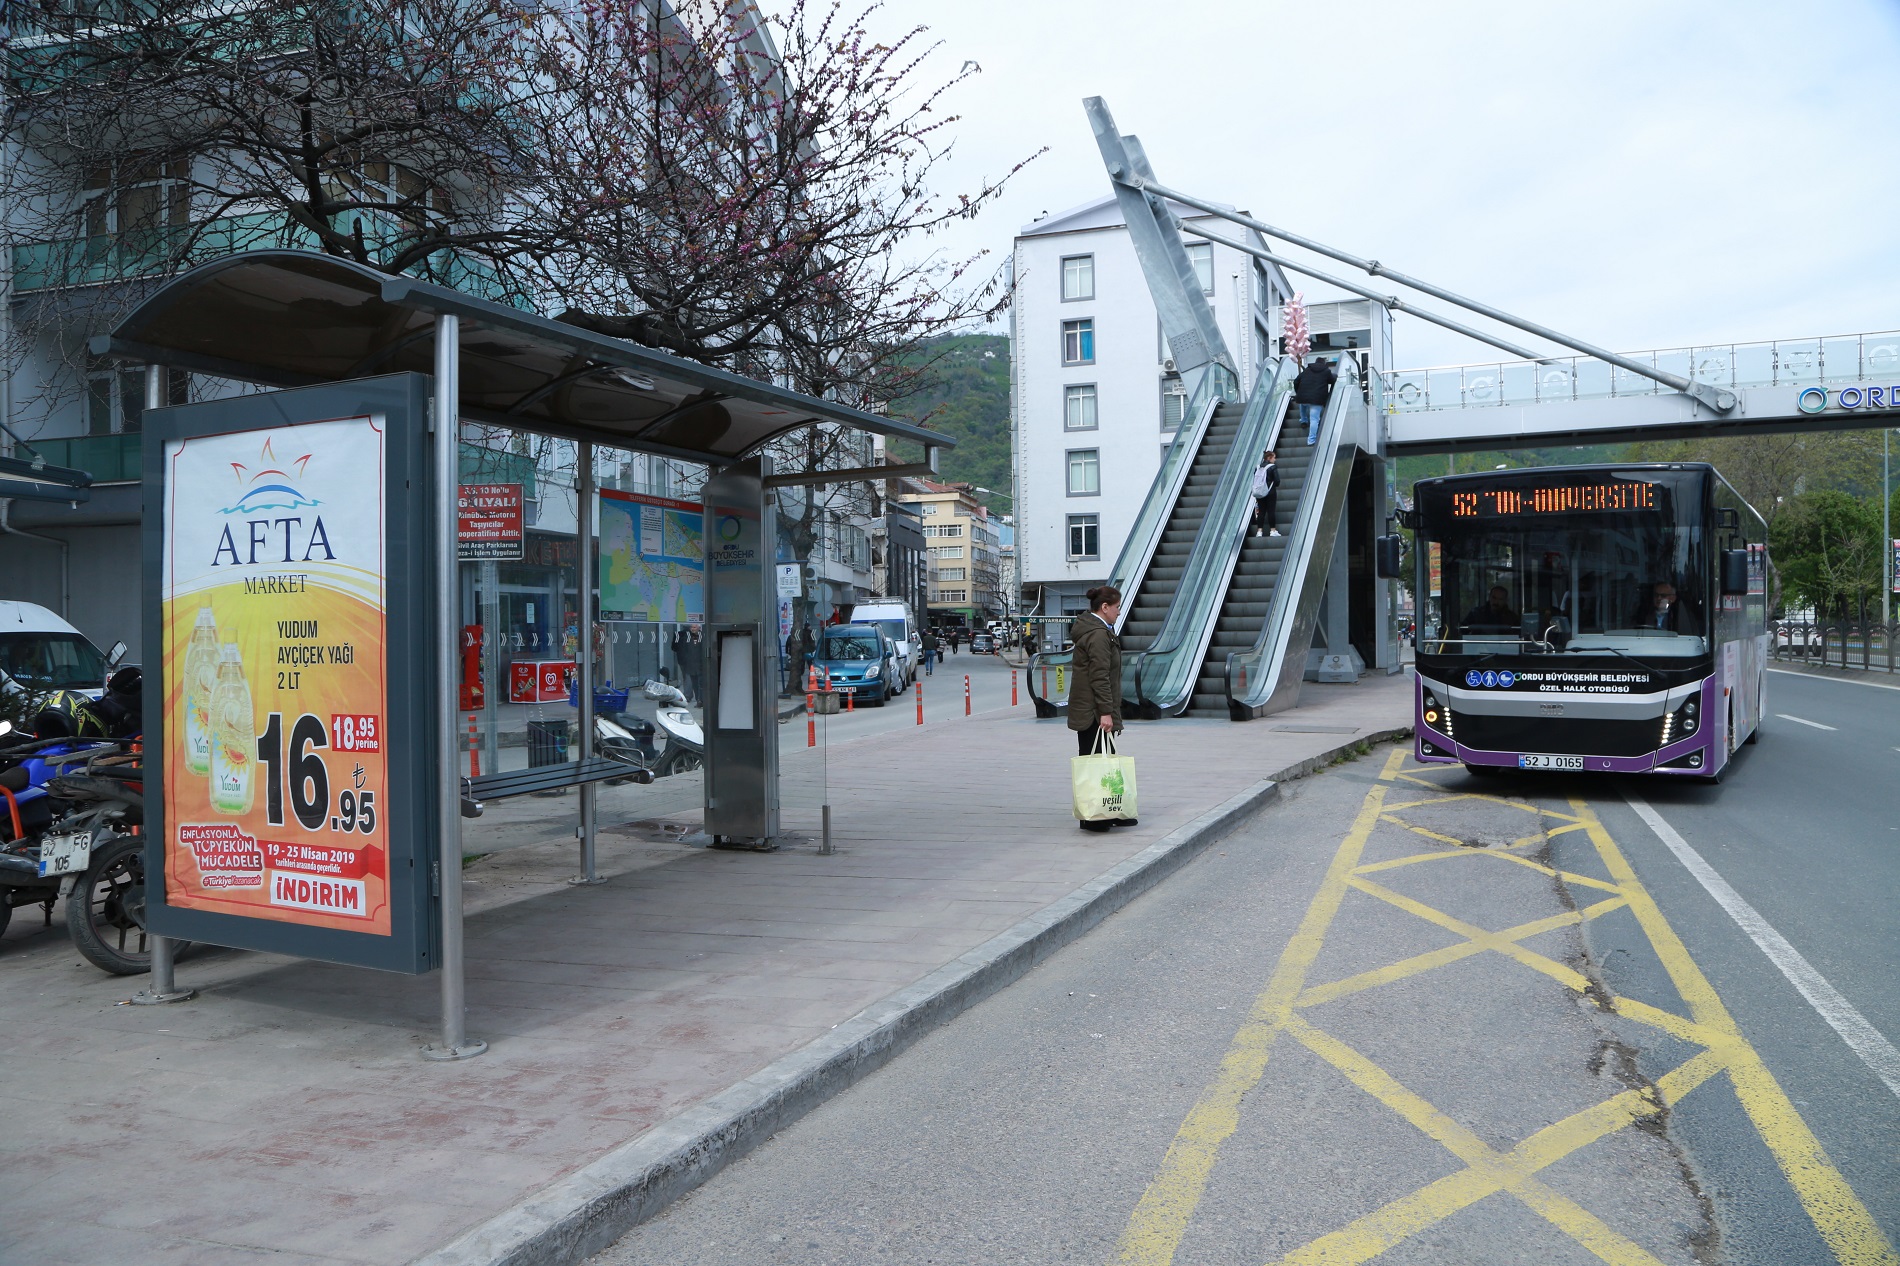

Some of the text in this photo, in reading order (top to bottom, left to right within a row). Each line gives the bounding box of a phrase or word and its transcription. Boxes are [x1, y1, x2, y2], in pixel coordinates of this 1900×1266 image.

[1454, 493, 1477, 516] 52
[469, 521, 505, 529] Taşıyıcılar
[210, 515, 337, 566] AFTA
[458, 530, 500, 538] ooperatifine
[244, 574, 307, 595] MARKET
[277, 620, 318, 639] YUDUM
[277, 642, 354, 668] AYÇİÇEK YAĞI
[277, 672, 301, 690] 2 LT
[1521, 672, 1650, 683] ORDU BÜYÜKŞEHİR BELEDİYESİ
[1539, 683, 1561, 691] ÖZEL
[1587, 684, 1630, 693] OTOBÜSÜ
[355, 738, 378, 750] yerine
[1525, 756, 1582, 768] 52 J 0165
[182, 829, 239, 839] ENFLASYONLA
[267, 844, 280, 856] 19
[287, 845, 299, 858] 25
[301, 846, 328, 861] Nisan
[330, 850, 355, 864] 2019
[54, 855, 71, 872] 105
[201, 855, 260, 868] MÜCADELE
[275, 858, 296, 868] tarihleri
